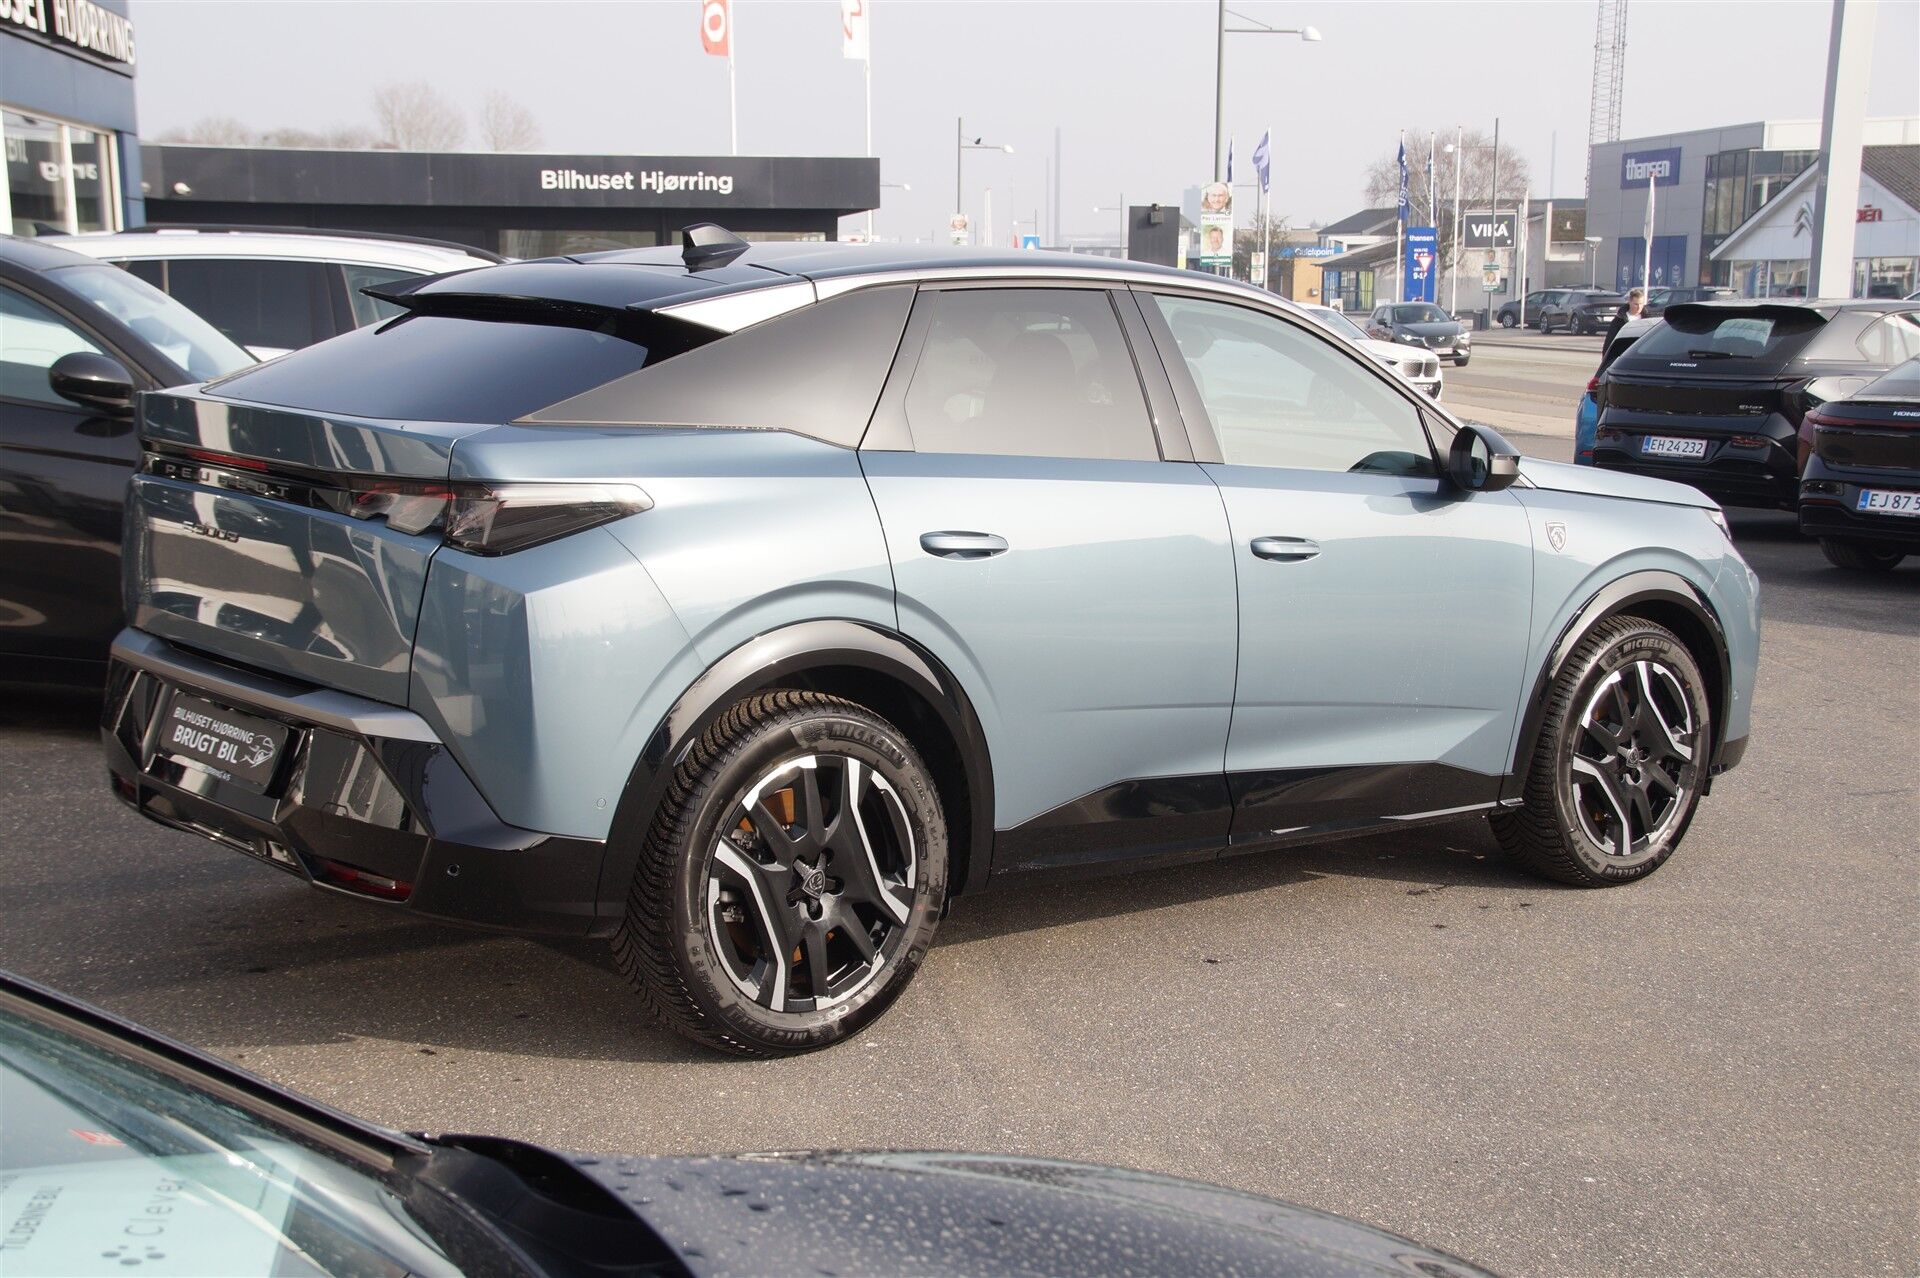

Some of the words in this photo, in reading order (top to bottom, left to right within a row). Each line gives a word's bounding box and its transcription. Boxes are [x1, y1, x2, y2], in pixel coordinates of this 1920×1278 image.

[1626, 159, 1670, 180] thansen
[540, 170, 635, 190] Bilhuset
[640, 171, 734, 194] Hjørring
[1409, 234, 1434, 242] thansen
[1471, 223, 1509, 238] VIKA
[1650, 439, 1666, 451] EH
[1667, 440, 1681, 453] 24
[1682, 441, 1704, 454] 232
[1869, 493, 1890, 508] EJ
[1891, 494, 1912, 510] 87
[1622, 637, 1672, 654] MICHELIN
[173, 706, 214, 729] BILHUSET
[211, 719, 255, 744] HJØRRING
[172, 724, 220, 755] BRUGT
[217, 740, 239, 764] BIL
